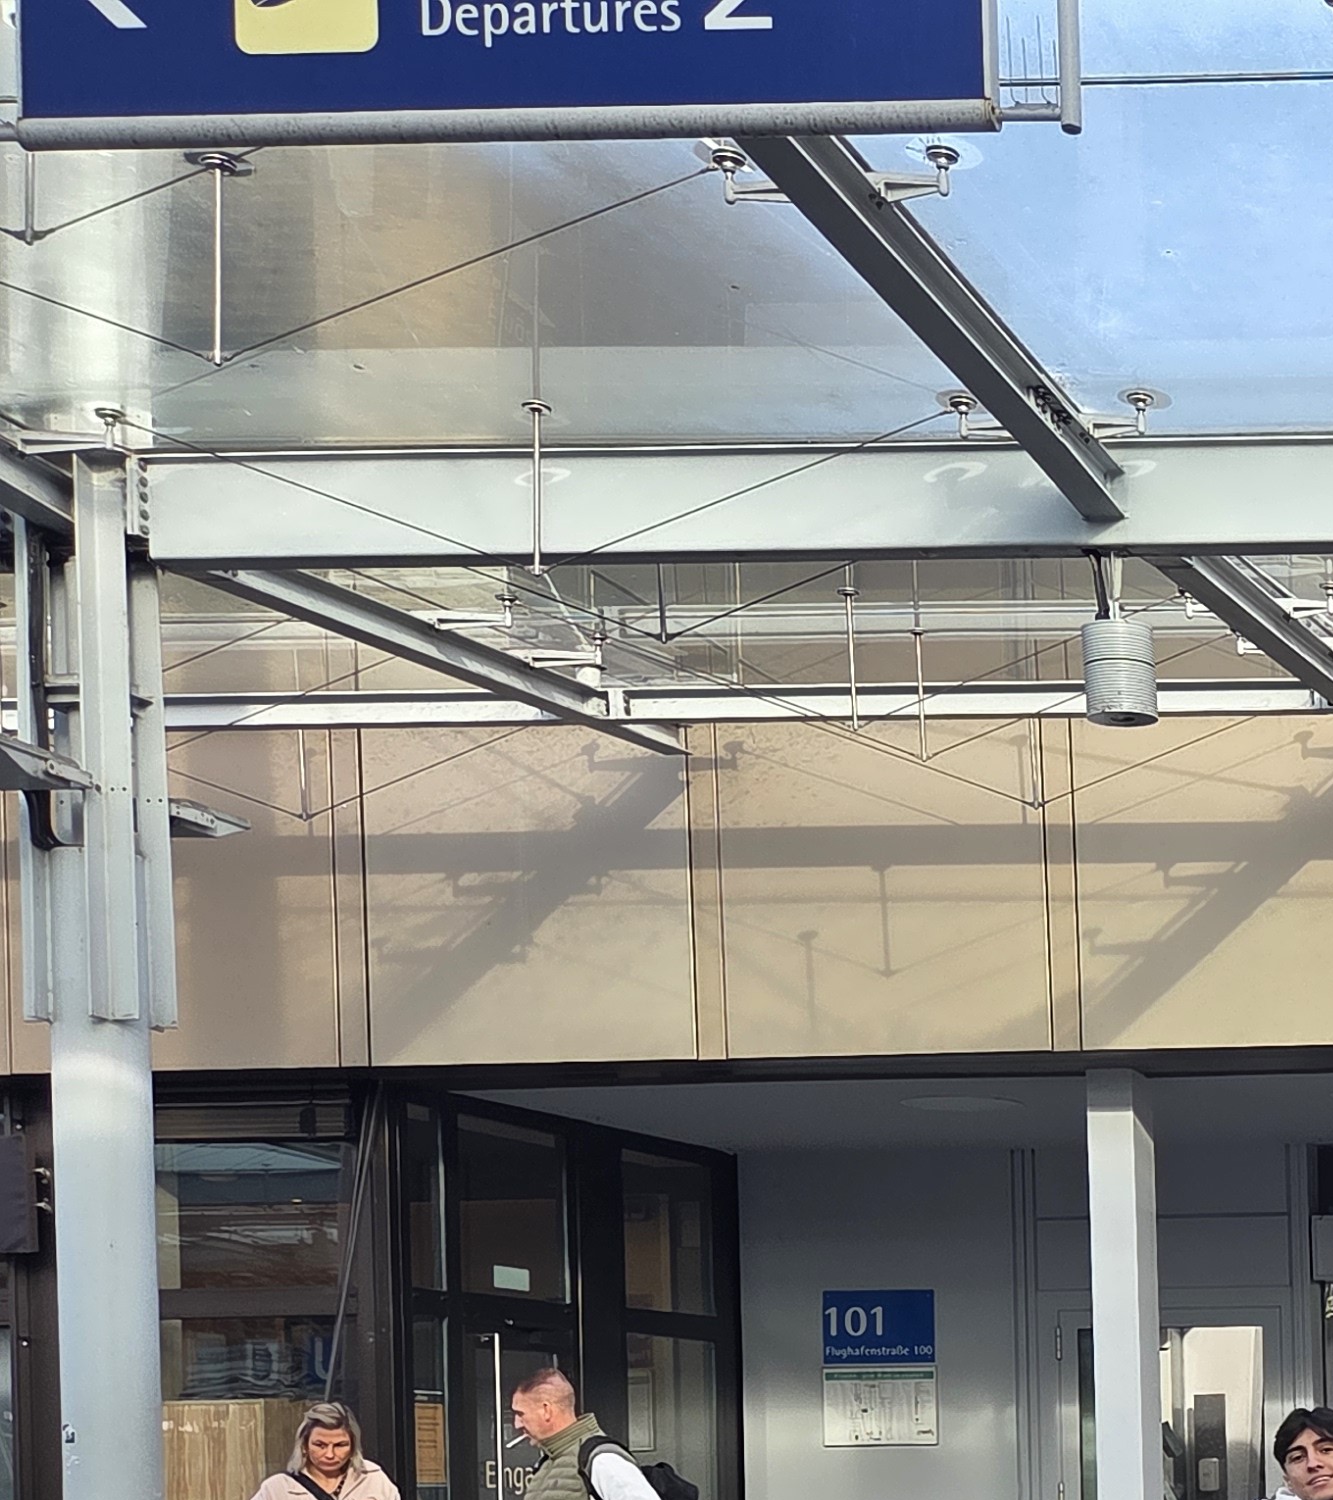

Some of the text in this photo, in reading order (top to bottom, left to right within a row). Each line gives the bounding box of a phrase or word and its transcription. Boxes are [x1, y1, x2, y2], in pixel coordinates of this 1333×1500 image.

[422, 0, 682, 48] Departures
[825, 1306, 883, 1336] 101
[825, 1345, 933, 1359] Flughafenstraße 100
[485, 1460, 534, 1495] Enga
